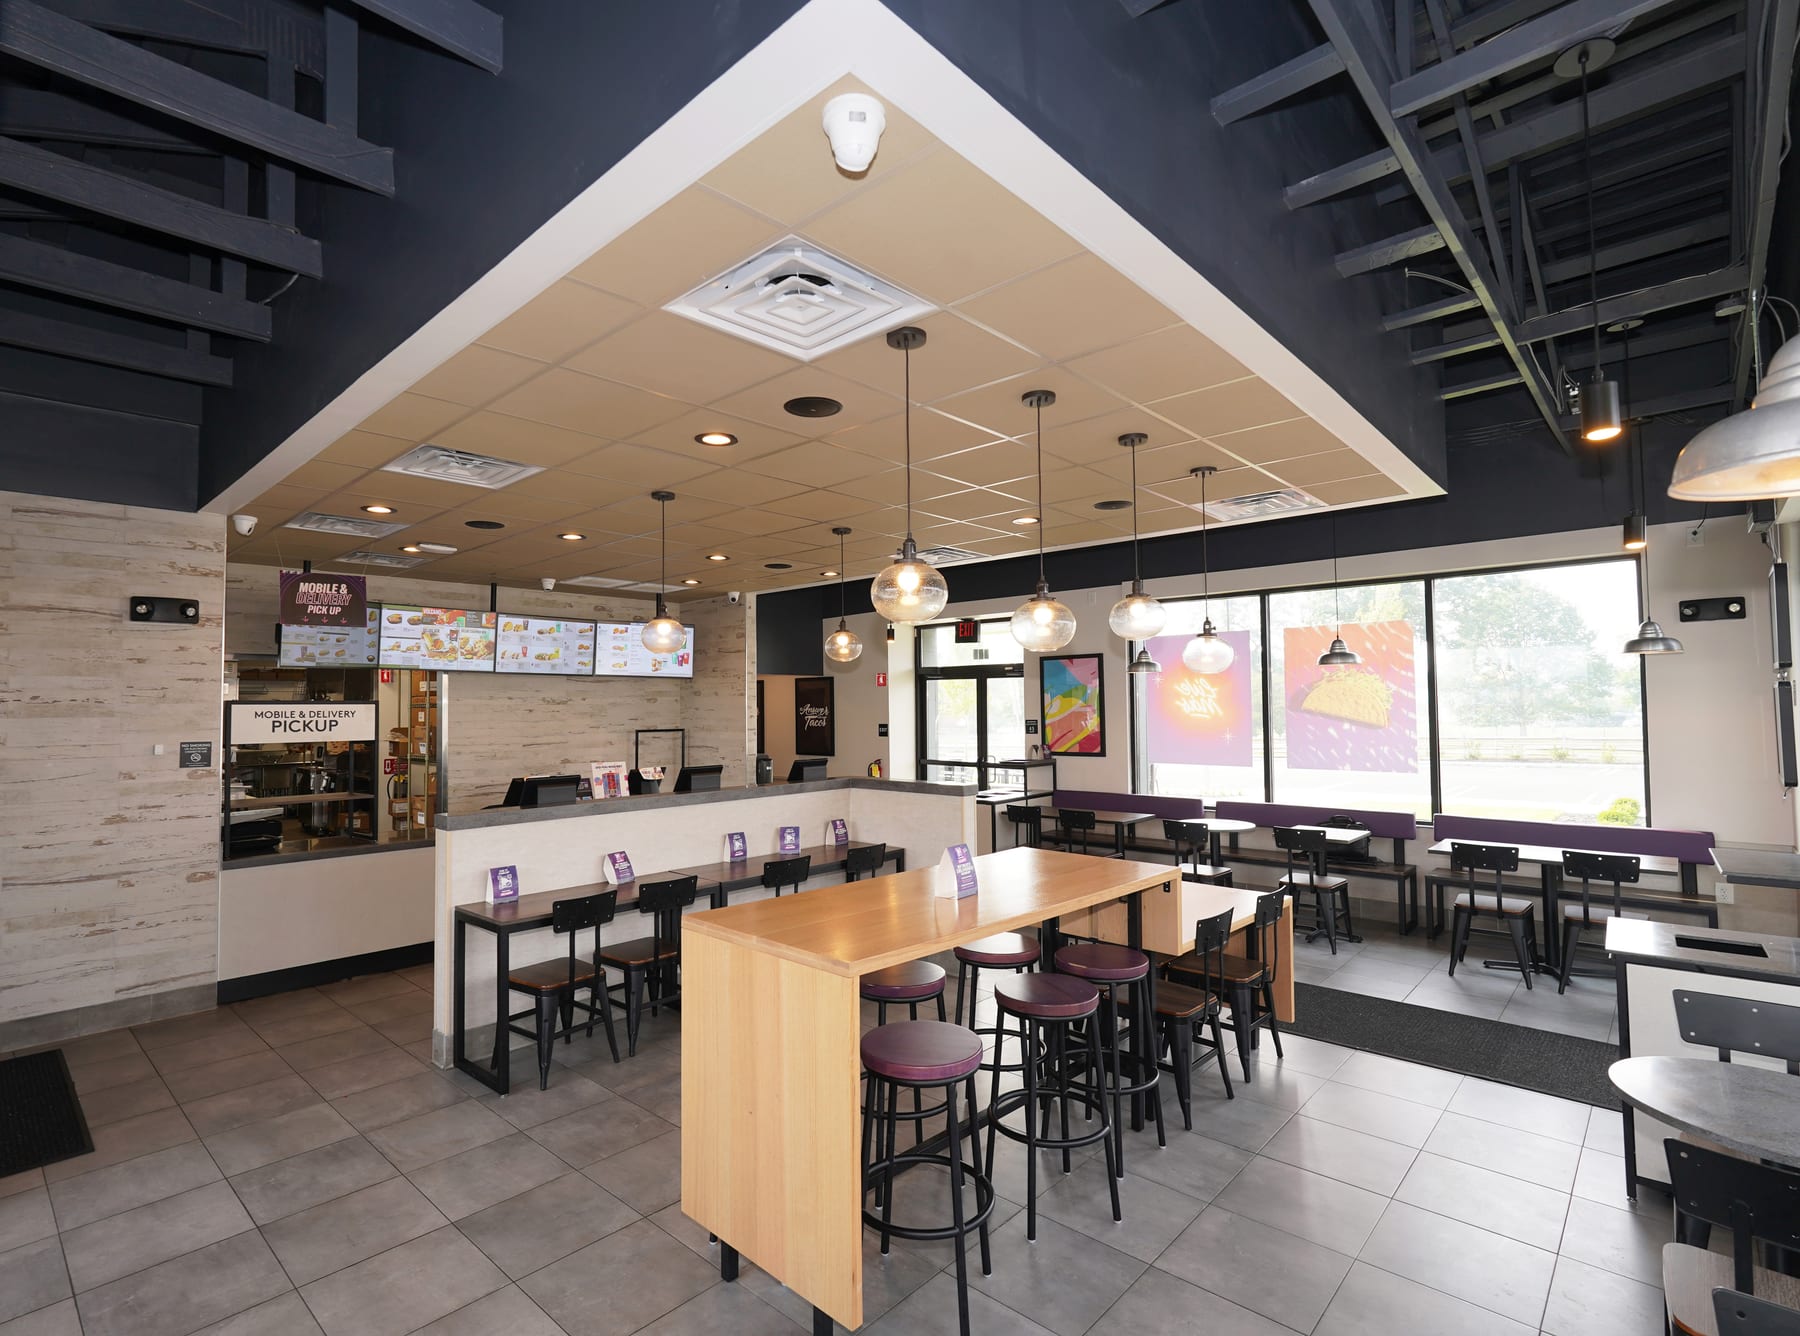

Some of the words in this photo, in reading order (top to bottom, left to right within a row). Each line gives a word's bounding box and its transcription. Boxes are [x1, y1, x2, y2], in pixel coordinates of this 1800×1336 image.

[299, 582, 338, 594] MOBILE
[339, 583, 348, 594] &
[295, 592, 352, 605] DELIVERY
[307, 605, 327, 615] PICK
[329, 606, 341, 615] UP
[959, 622, 975, 637] EXIT
[254, 710, 296, 719] MOBILE
[298, 710, 306, 719] &
[309, 710, 356, 719] DELIVERY
[272, 719, 339, 733] PICKUP
[805, 715, 827, 731] Tacos
